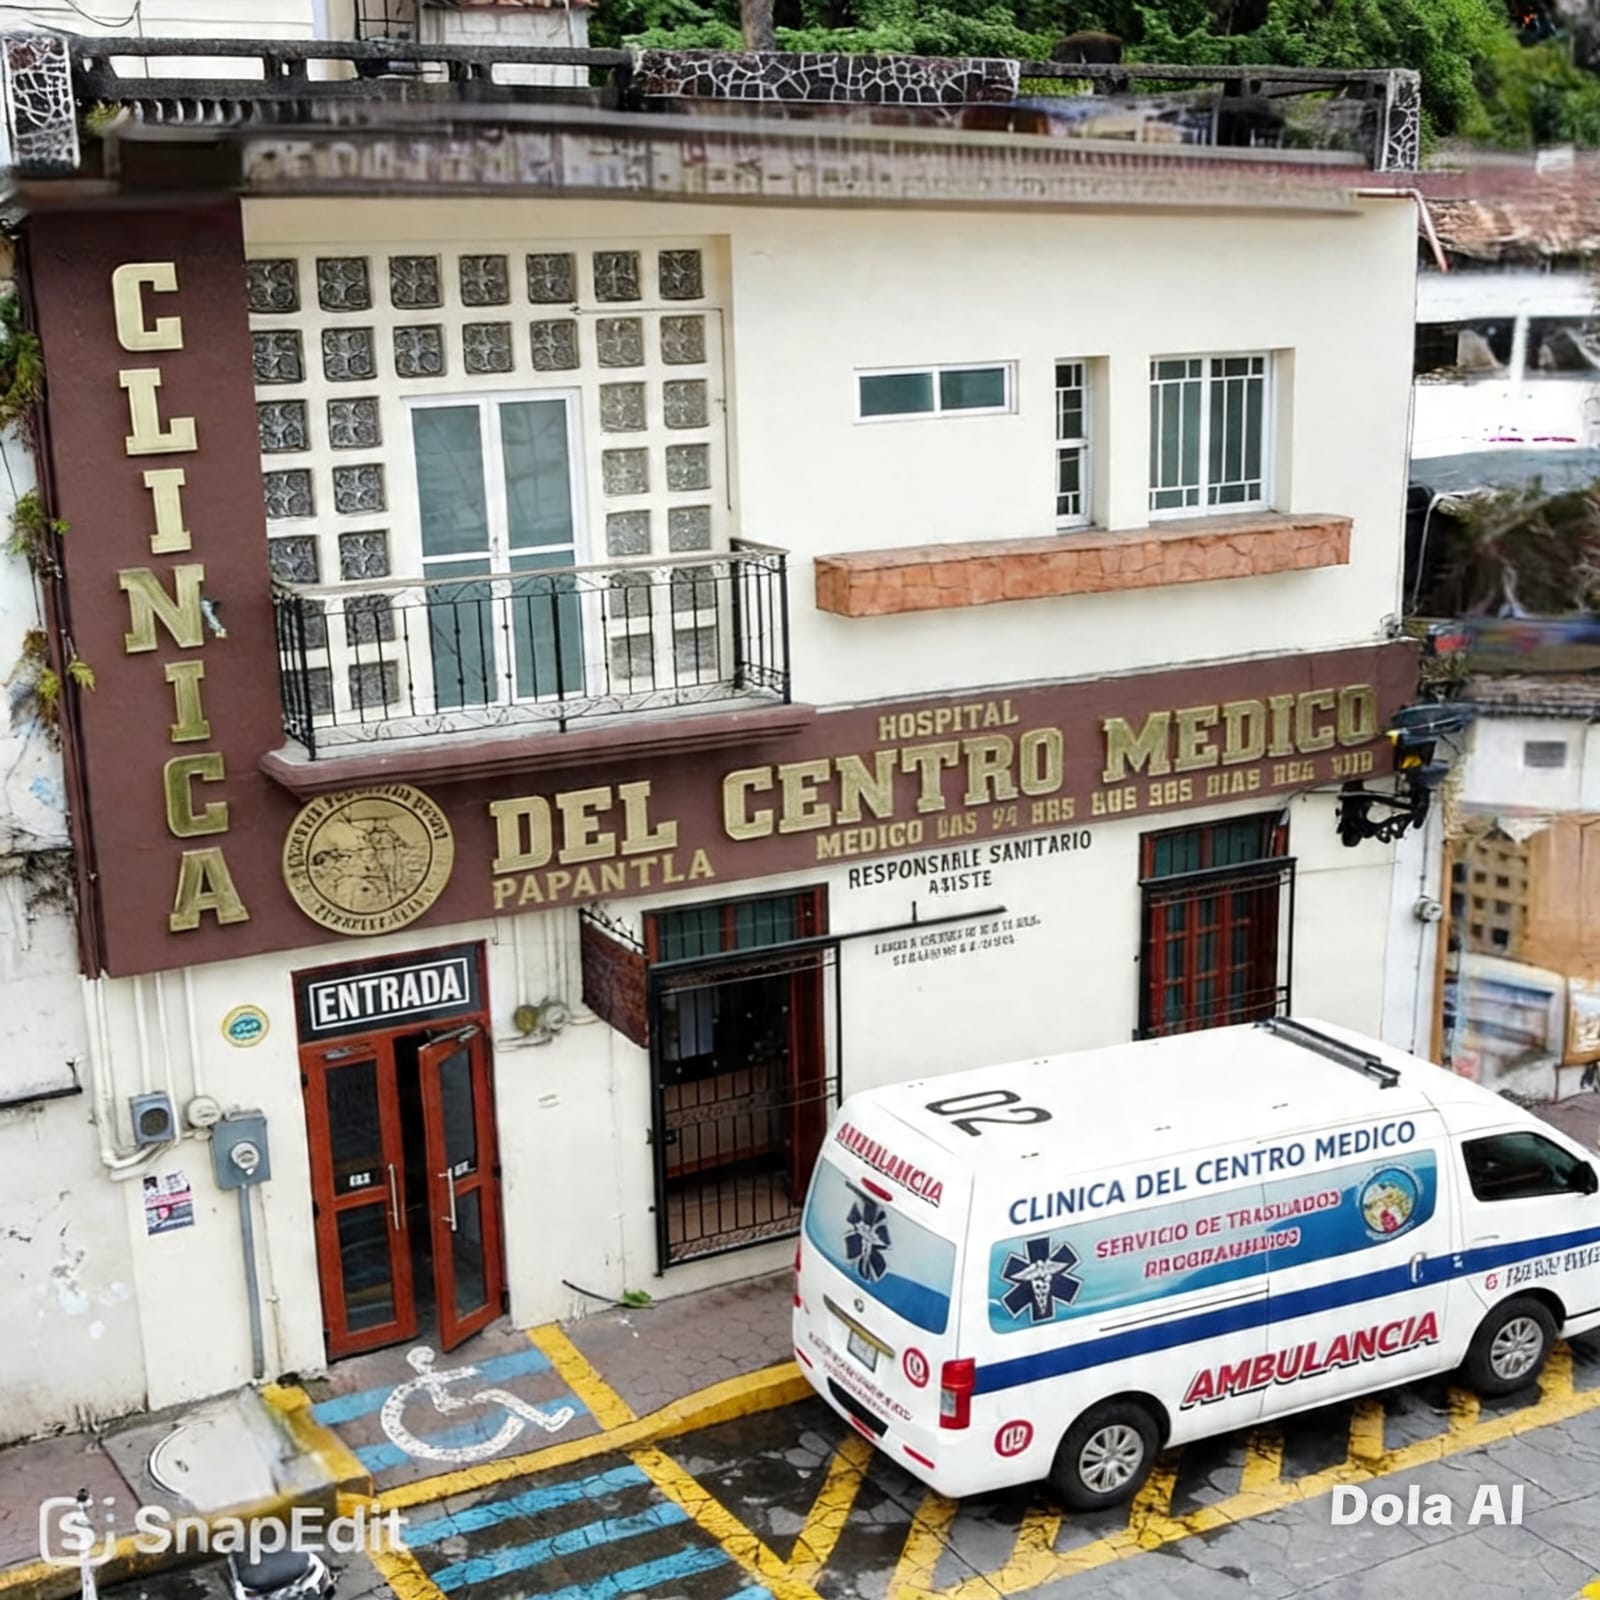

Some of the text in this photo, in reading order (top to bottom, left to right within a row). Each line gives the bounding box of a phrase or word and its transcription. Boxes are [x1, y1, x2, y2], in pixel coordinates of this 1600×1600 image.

[111, 261, 250, 934] CLINICA
[878, 700, 1020, 741] HOSPITAL
[489, 780, 678, 875] DEL
[722, 727, 1064, 841] CENTRO
[1101, 684, 1378, 784] MEDICO
[816, 819, 923, 861] MEDICO
[989, 830, 1092, 864] SANITARIO
[492, 849, 716, 910] PAPANTLA
[319, 965, 463, 1023] ENTRADA
[925, 1089, 1053, 1138] 02
[1008, 1120, 1417, 1226] CLINICA DEL CENTRO MEDICO
[1179, 1311, 1439, 1411] AMBULANCIA
